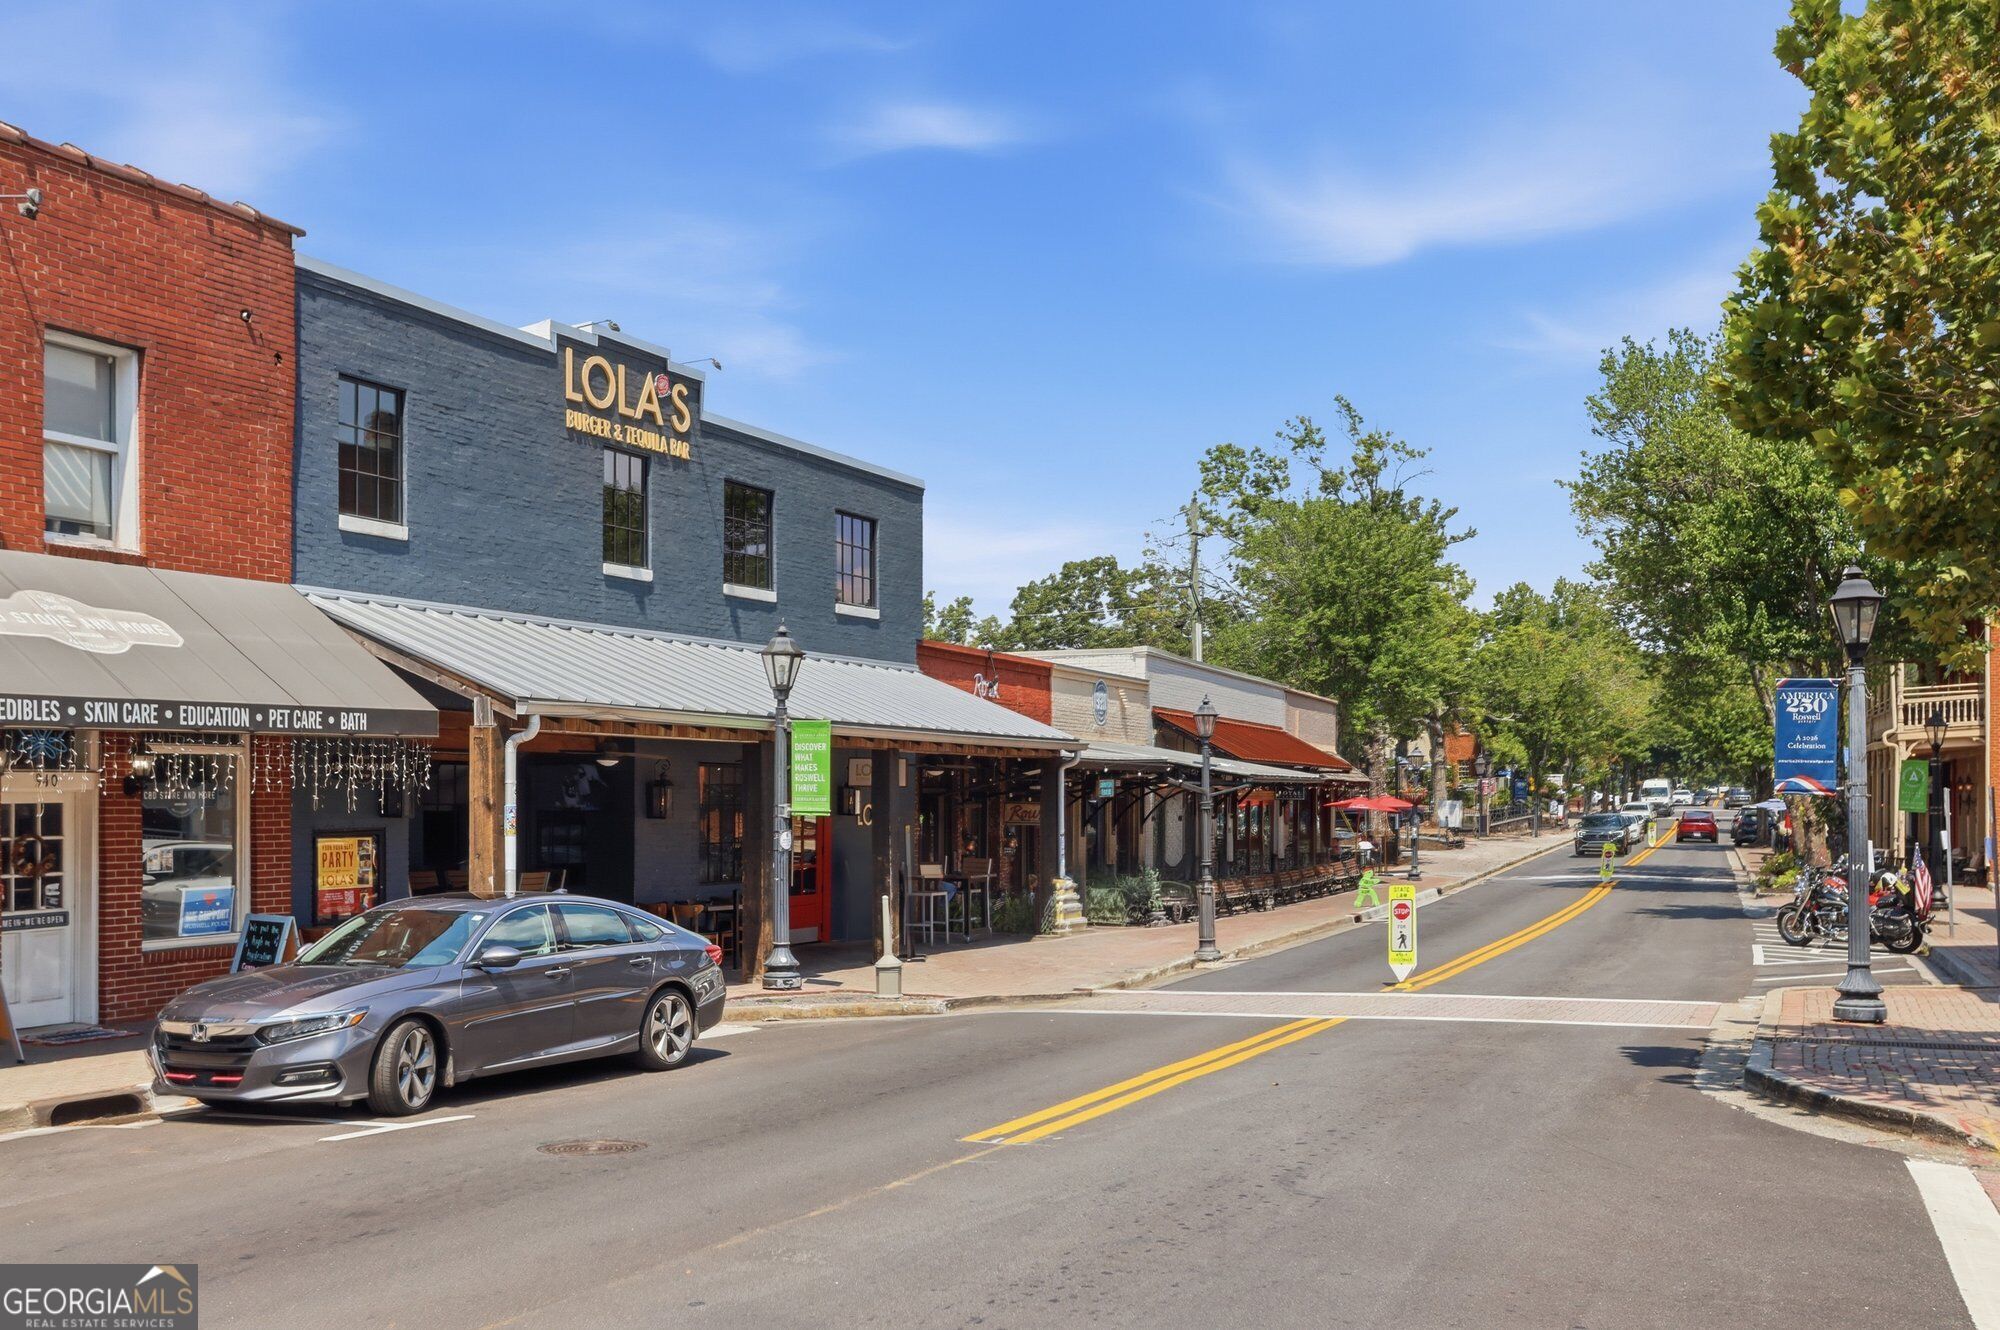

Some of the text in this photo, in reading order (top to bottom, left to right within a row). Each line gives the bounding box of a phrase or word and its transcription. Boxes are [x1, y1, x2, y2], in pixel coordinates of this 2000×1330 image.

[565, 347, 691, 434] LOLA'S
[566, 409, 691, 460] BURGER & TEQUILA BAR
[1780, 691, 1834, 700] AMERICA
[1785, 698, 1828, 713] 250
[0, 698, 367, 731] EDIBLES SKIN CARE EDUCATION PET CARE BATH
[1792, 713, 1821, 721] Roswell
[794, 743, 827, 751] DISCOVER
[1787, 742, 1826, 750] Celebration
[794, 753, 813, 761] WHAT
[794, 763, 818, 772] MAKES
[794, 774, 826, 782] ROSWELL
[794, 784, 818, 792] THRIVE
[143, 791, 157, 800] CBD
[183, 791, 196, 799] AND
[322, 851, 354, 868] PARTY
[322, 873, 354, 886] LOLA'S
